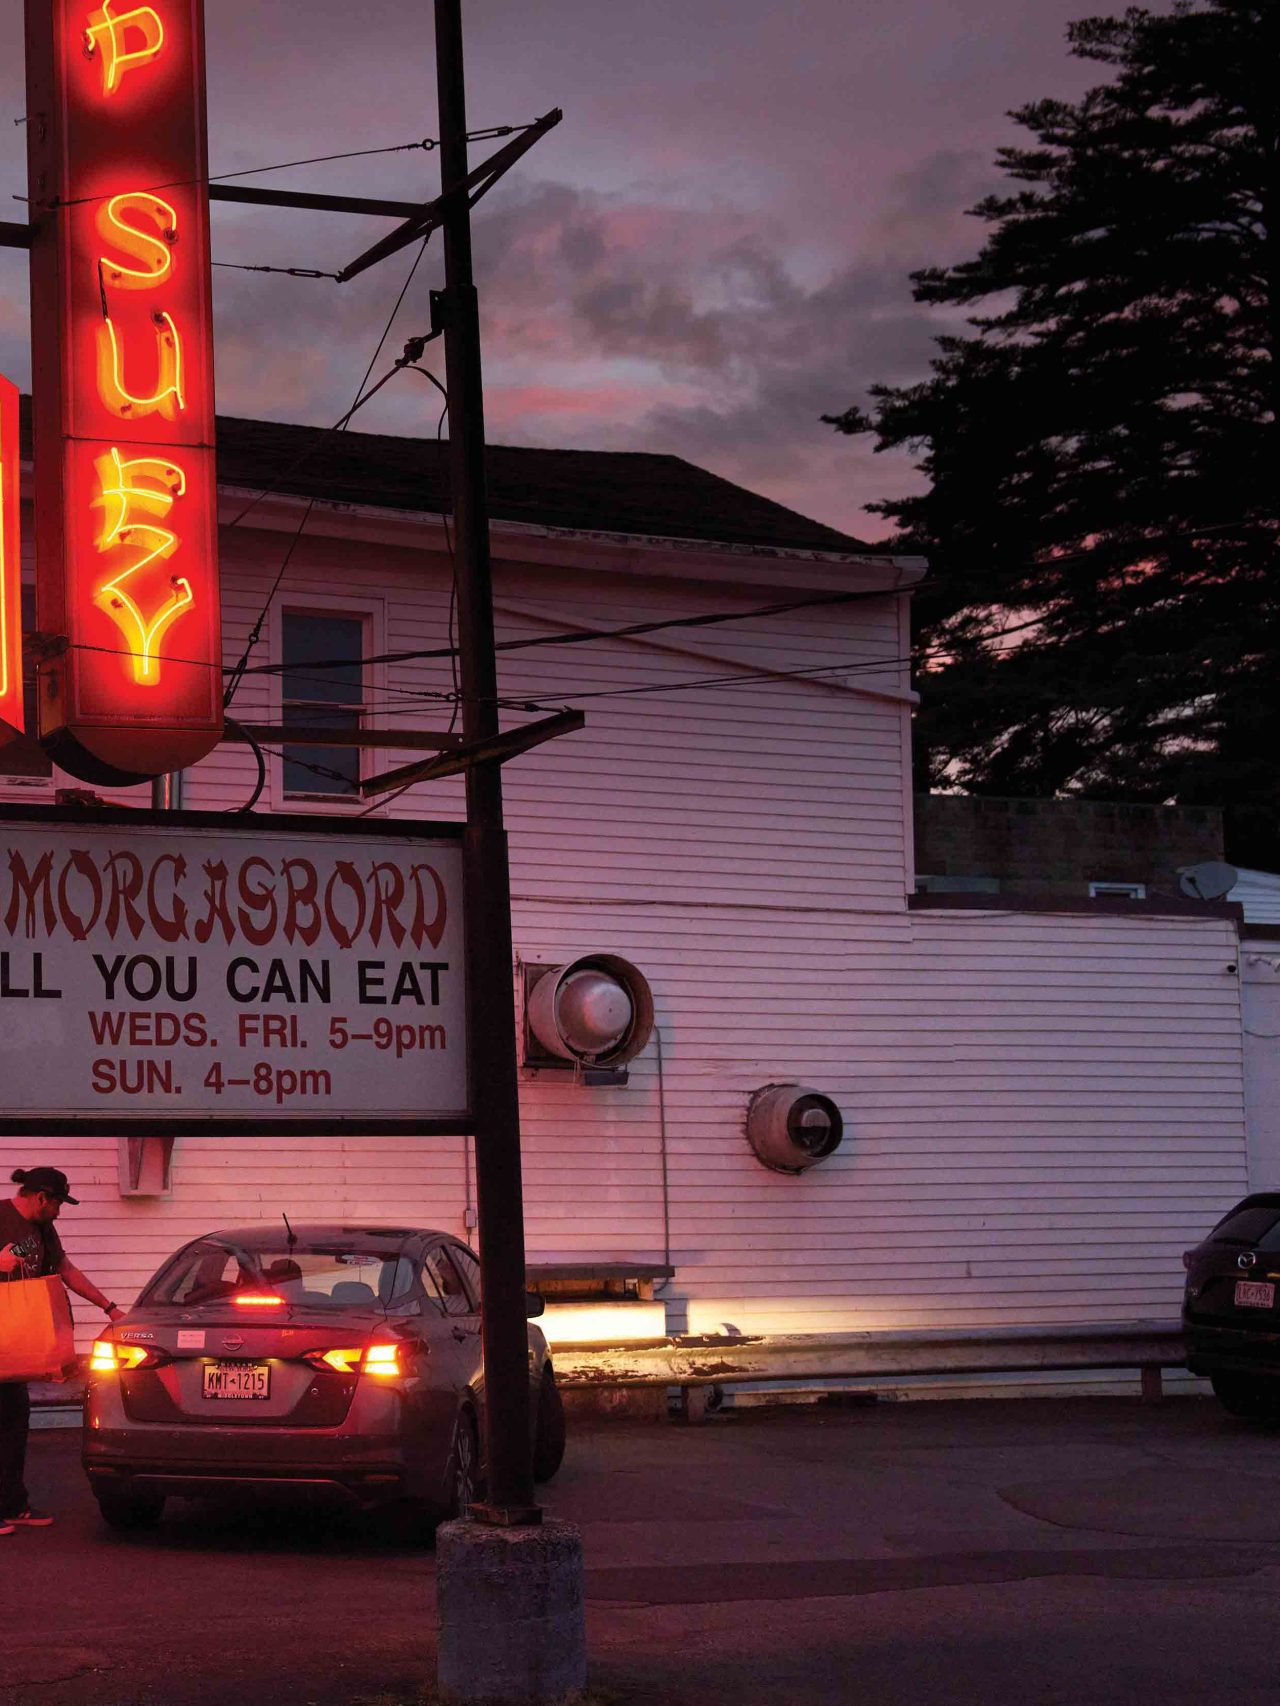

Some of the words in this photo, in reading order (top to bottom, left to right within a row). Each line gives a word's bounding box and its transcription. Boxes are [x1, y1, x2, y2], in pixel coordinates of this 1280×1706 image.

[89, 190, 194, 688] SUEY
[92, 954, 197, 1002] YOU
[226, 956, 331, 1004] CAN
[358, 960, 449, 1006] EAT
[88, 1012, 218, 1048] WEDS.
[239, 1014, 308, 1049] FRI.
[91, 1059, 182, 1094] SUN.
